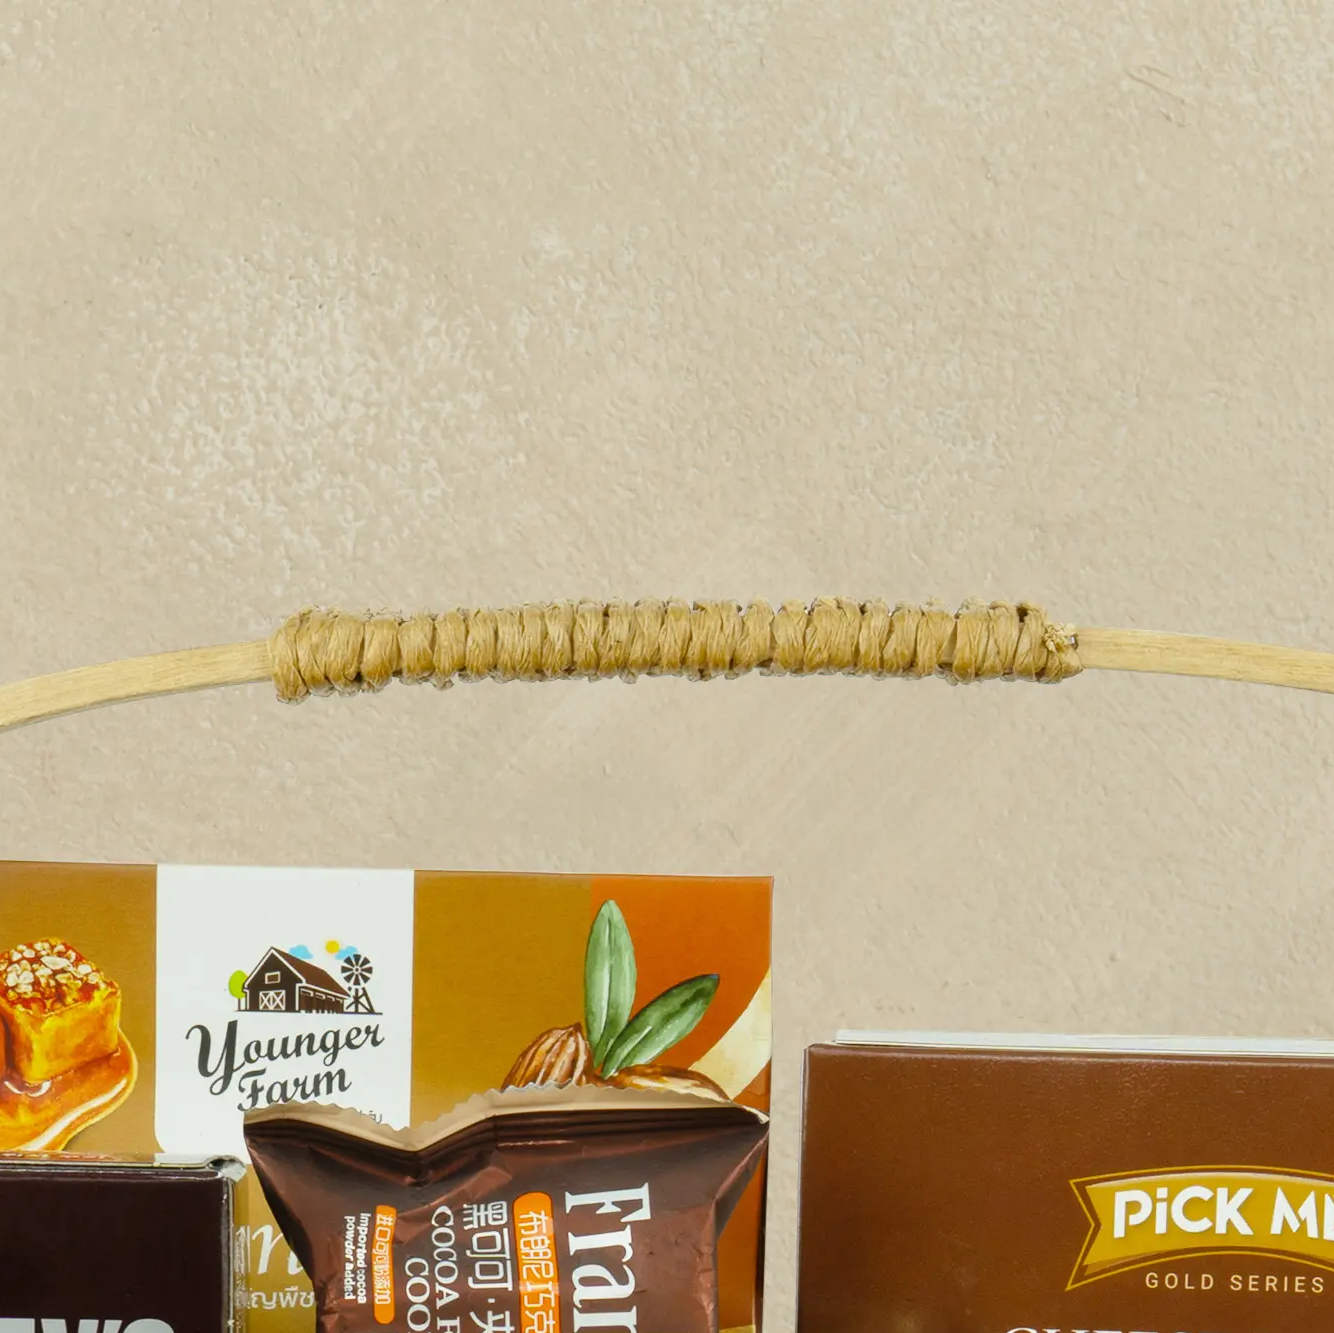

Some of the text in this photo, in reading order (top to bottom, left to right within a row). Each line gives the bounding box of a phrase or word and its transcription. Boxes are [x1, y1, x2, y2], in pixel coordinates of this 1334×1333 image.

[186, 1020, 384, 1095] Younger
[237, 1068, 352, 1111] Farm
[343, 1216, 356, 1300] powder added
[357, 1213, 371, 1304] Imported cocoa
[432, 1205, 460, 1310] COCOA
[1145, 1272, 1324, 1293] GOLD SERIES
